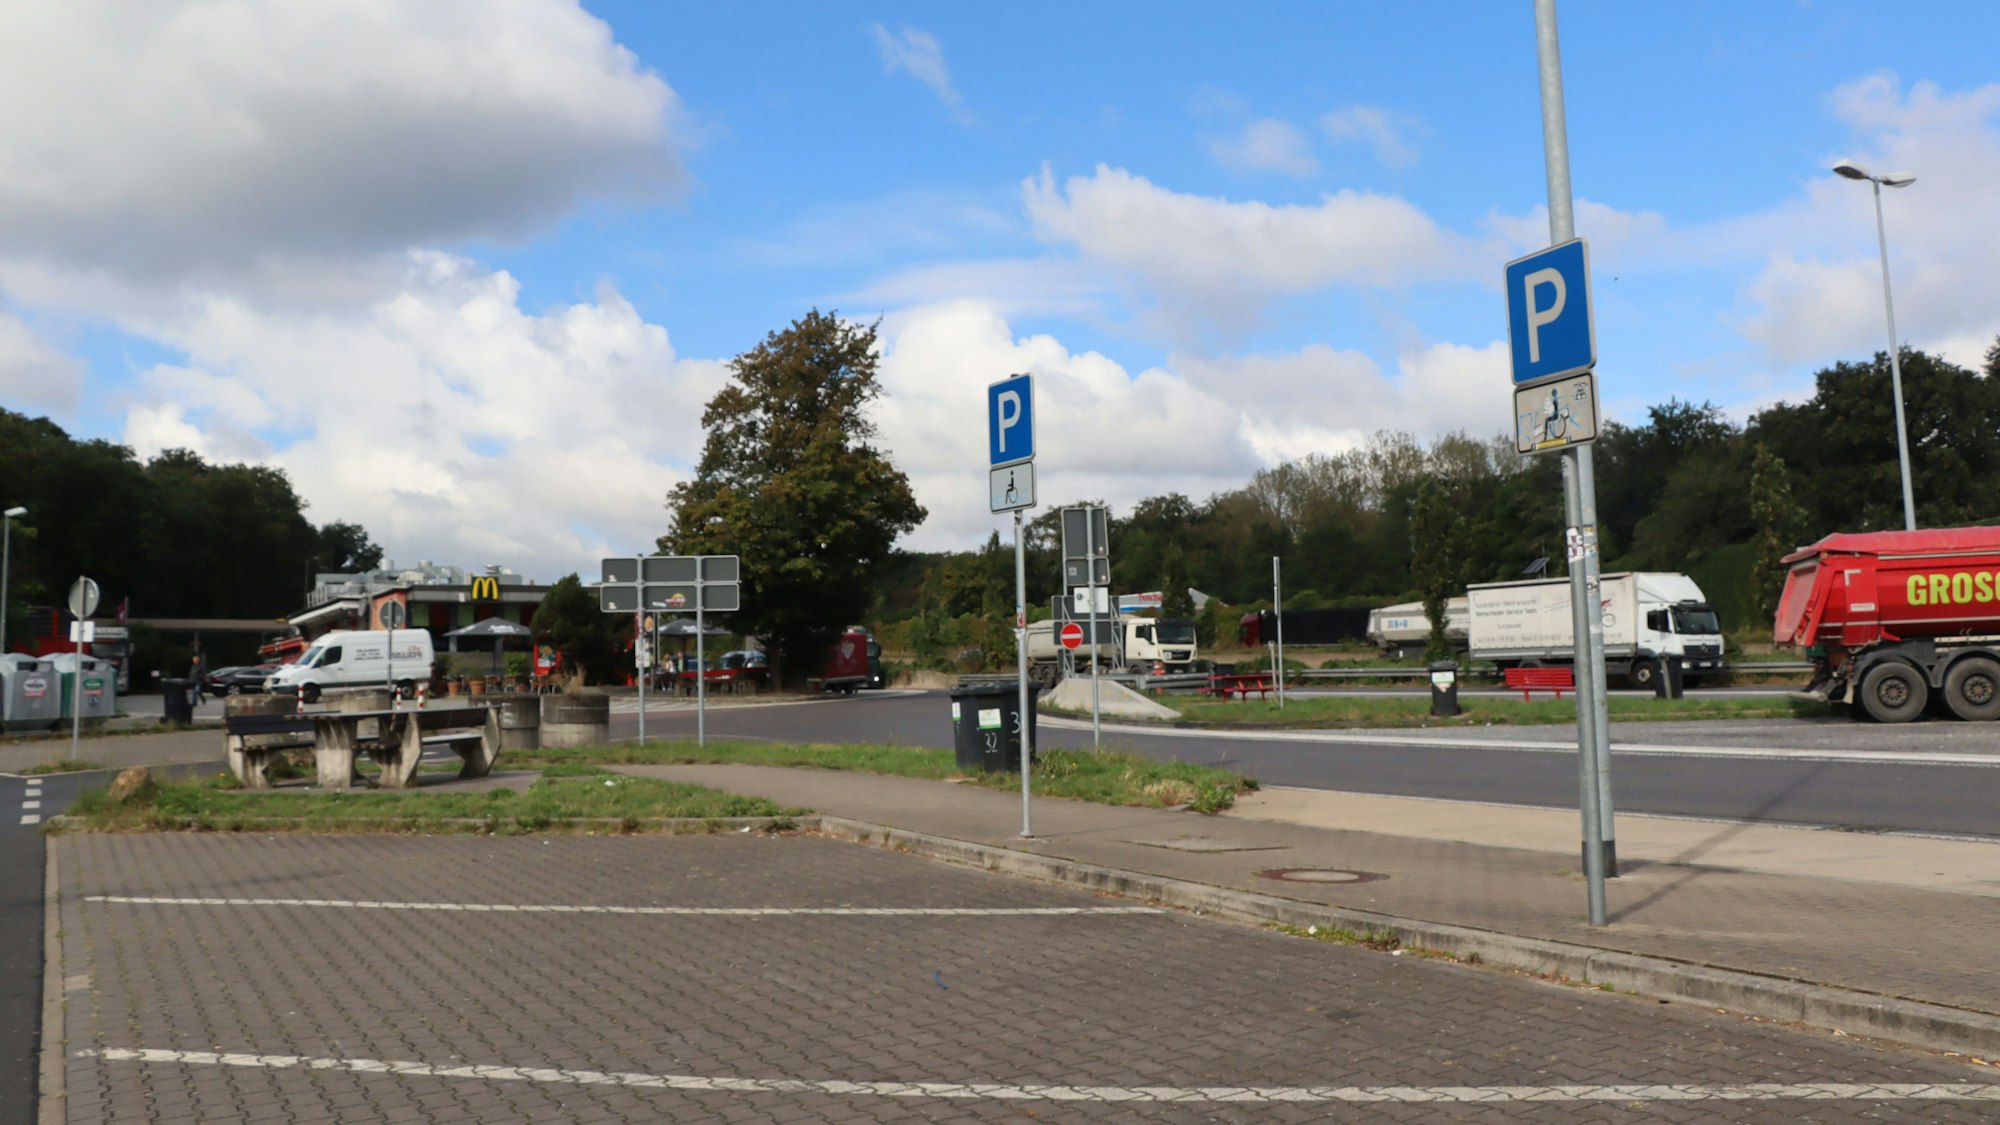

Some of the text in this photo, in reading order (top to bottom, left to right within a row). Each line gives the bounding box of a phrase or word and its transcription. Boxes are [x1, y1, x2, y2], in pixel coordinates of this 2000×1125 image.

[1524, 267, 1567, 364] P
[999, 391, 1021, 453] P
[1907, 571, 2000, 605] GROS
[984, 732, 998, 754] 32
